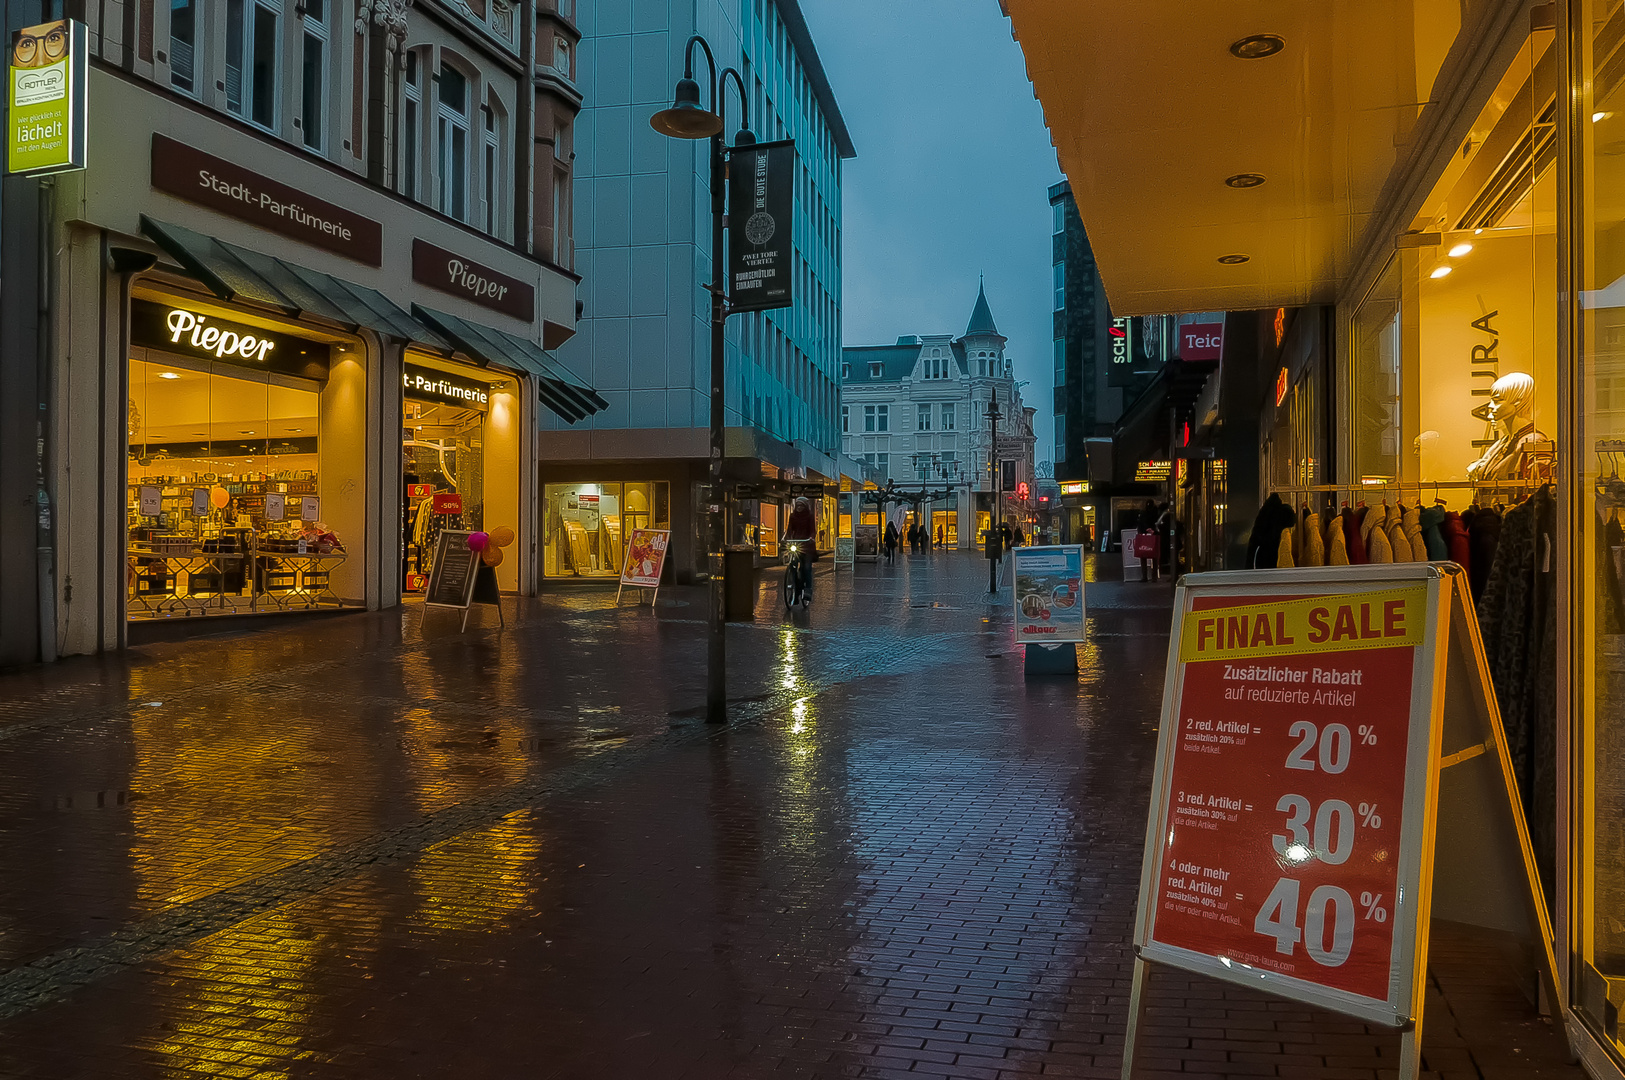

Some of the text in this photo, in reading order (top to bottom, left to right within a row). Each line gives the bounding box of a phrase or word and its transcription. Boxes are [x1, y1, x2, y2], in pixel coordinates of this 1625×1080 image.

[30, 111, 53, 123] glücklich
[17, 121, 62, 143] lächelt
[17, 140, 62, 153] mit den Augen!
[757, 154, 766, 208] DIE GUTE STUBE
[199, 170, 351, 241] Stadt-Parfümerie
[742, 250, 778, 262] ZWEI TORE
[746, 258, 774, 266] VIERTEL
[448, 259, 508, 300] Pieper
[736, 280, 762, 290] EINKAUFEN
[167, 310, 274, 360] Pieper
[1186, 334, 1220, 348] Teic
[1022, 625, 1057, 634] alltours
[1197, 599, 1406, 652] FINAL SALE
[1223, 665, 1362, 686] Zusätzlicher Rabatt
[1224, 685, 1356, 706] auf reduzierte Artikel
[1186, 718, 1193, 730] 2
[1196, 720, 1214, 731] red.
[1216, 721, 1250, 734] Artikel
[1184, 744, 1200, 752] beide
[1185, 733, 1246, 746] zusätzlich 20% auf
[1178, 791, 1184, 802] 3
[1187, 794, 1205, 805] red.
[1208, 795, 1242, 810] Artikel
[1175, 816, 1184, 826] die
[1186, 818, 1197, 827] drei
[1176, 806, 1238, 822] zusätzlich 30% auf
[1170, 859, 1230, 882] 4 oder mehr
[1168, 876, 1186, 889] red.
[1189, 880, 1222, 896] Artikel
[1166, 890, 1228, 910] zusätzlich 40% auf
[1164, 901, 1174, 910] die
[1176, 904, 1186, 912] vier
[1188, 906, 1201, 916] oder
[1202, 909, 1218, 920] mehr
[1227, 948, 1295, 972] www.gina-laura.com
